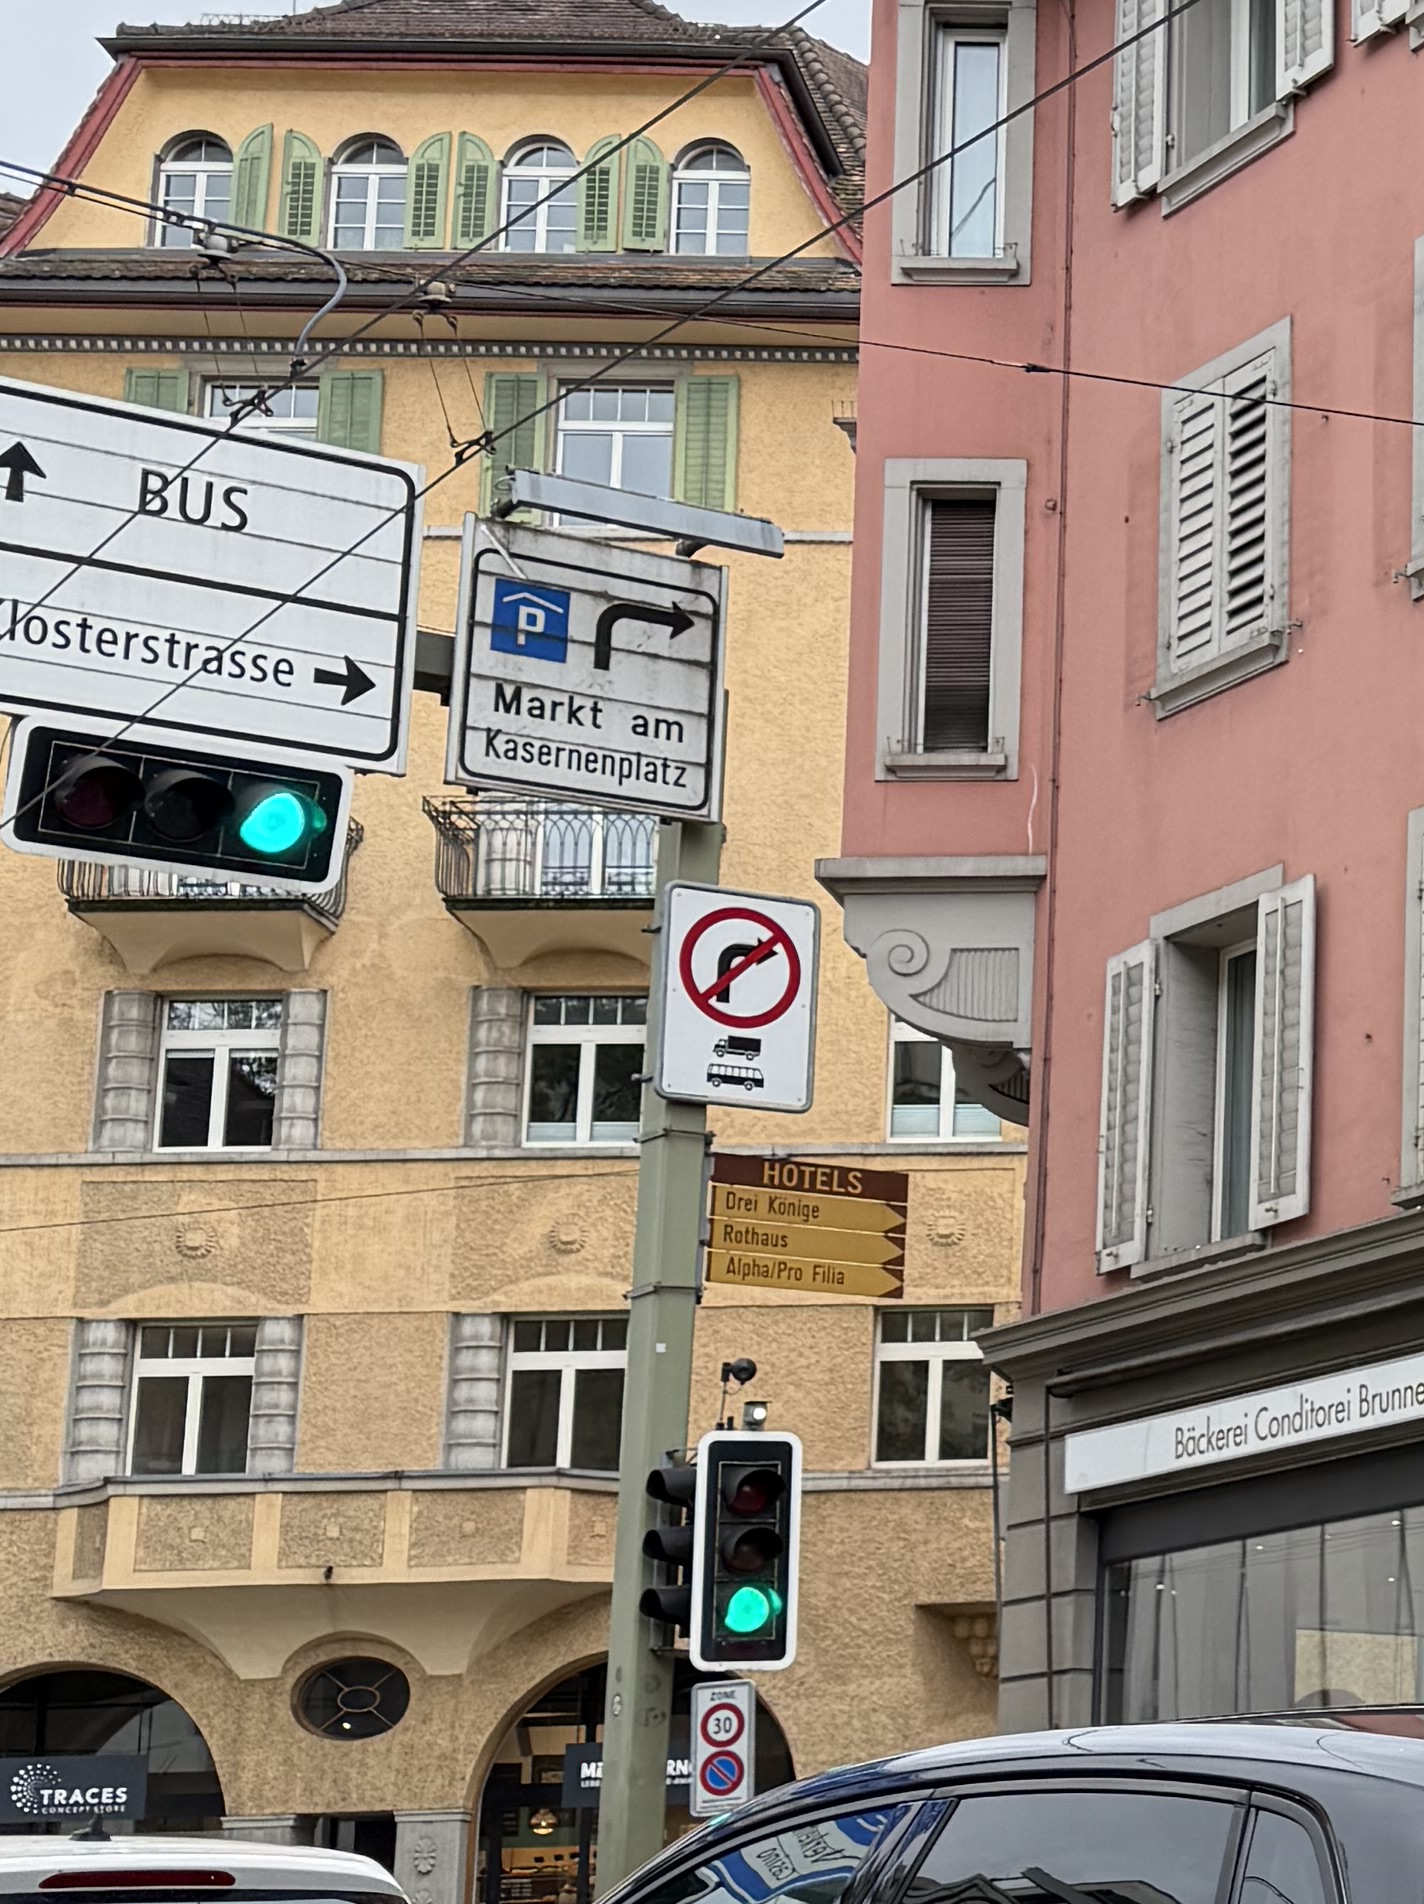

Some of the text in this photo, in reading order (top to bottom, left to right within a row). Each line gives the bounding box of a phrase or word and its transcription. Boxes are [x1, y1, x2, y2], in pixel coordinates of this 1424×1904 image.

[138, 468, 248, 532] BUS
[0, 598, 294, 687] losterstrasse
[493, 682, 684, 743] Markt am
[484, 727, 687, 788] Kasernenplatz
[763, 1161, 862, 1194] HOTELS
[726, 1191, 820, 1222] Drei Könige
[723, 1224, 788, 1248] Rothaus
[726, 1256, 845, 1285] Alpha/Pro Filia
[1175, 1412, 1248, 1460] Bäckerei
[1254, 1387, 1352, 1441] Conditorei
[713, 1716, 732, 1735] 30
[40, 1787, 128, 1805] TRACES
[42, 1805, 90, 1814] CONCEPT
